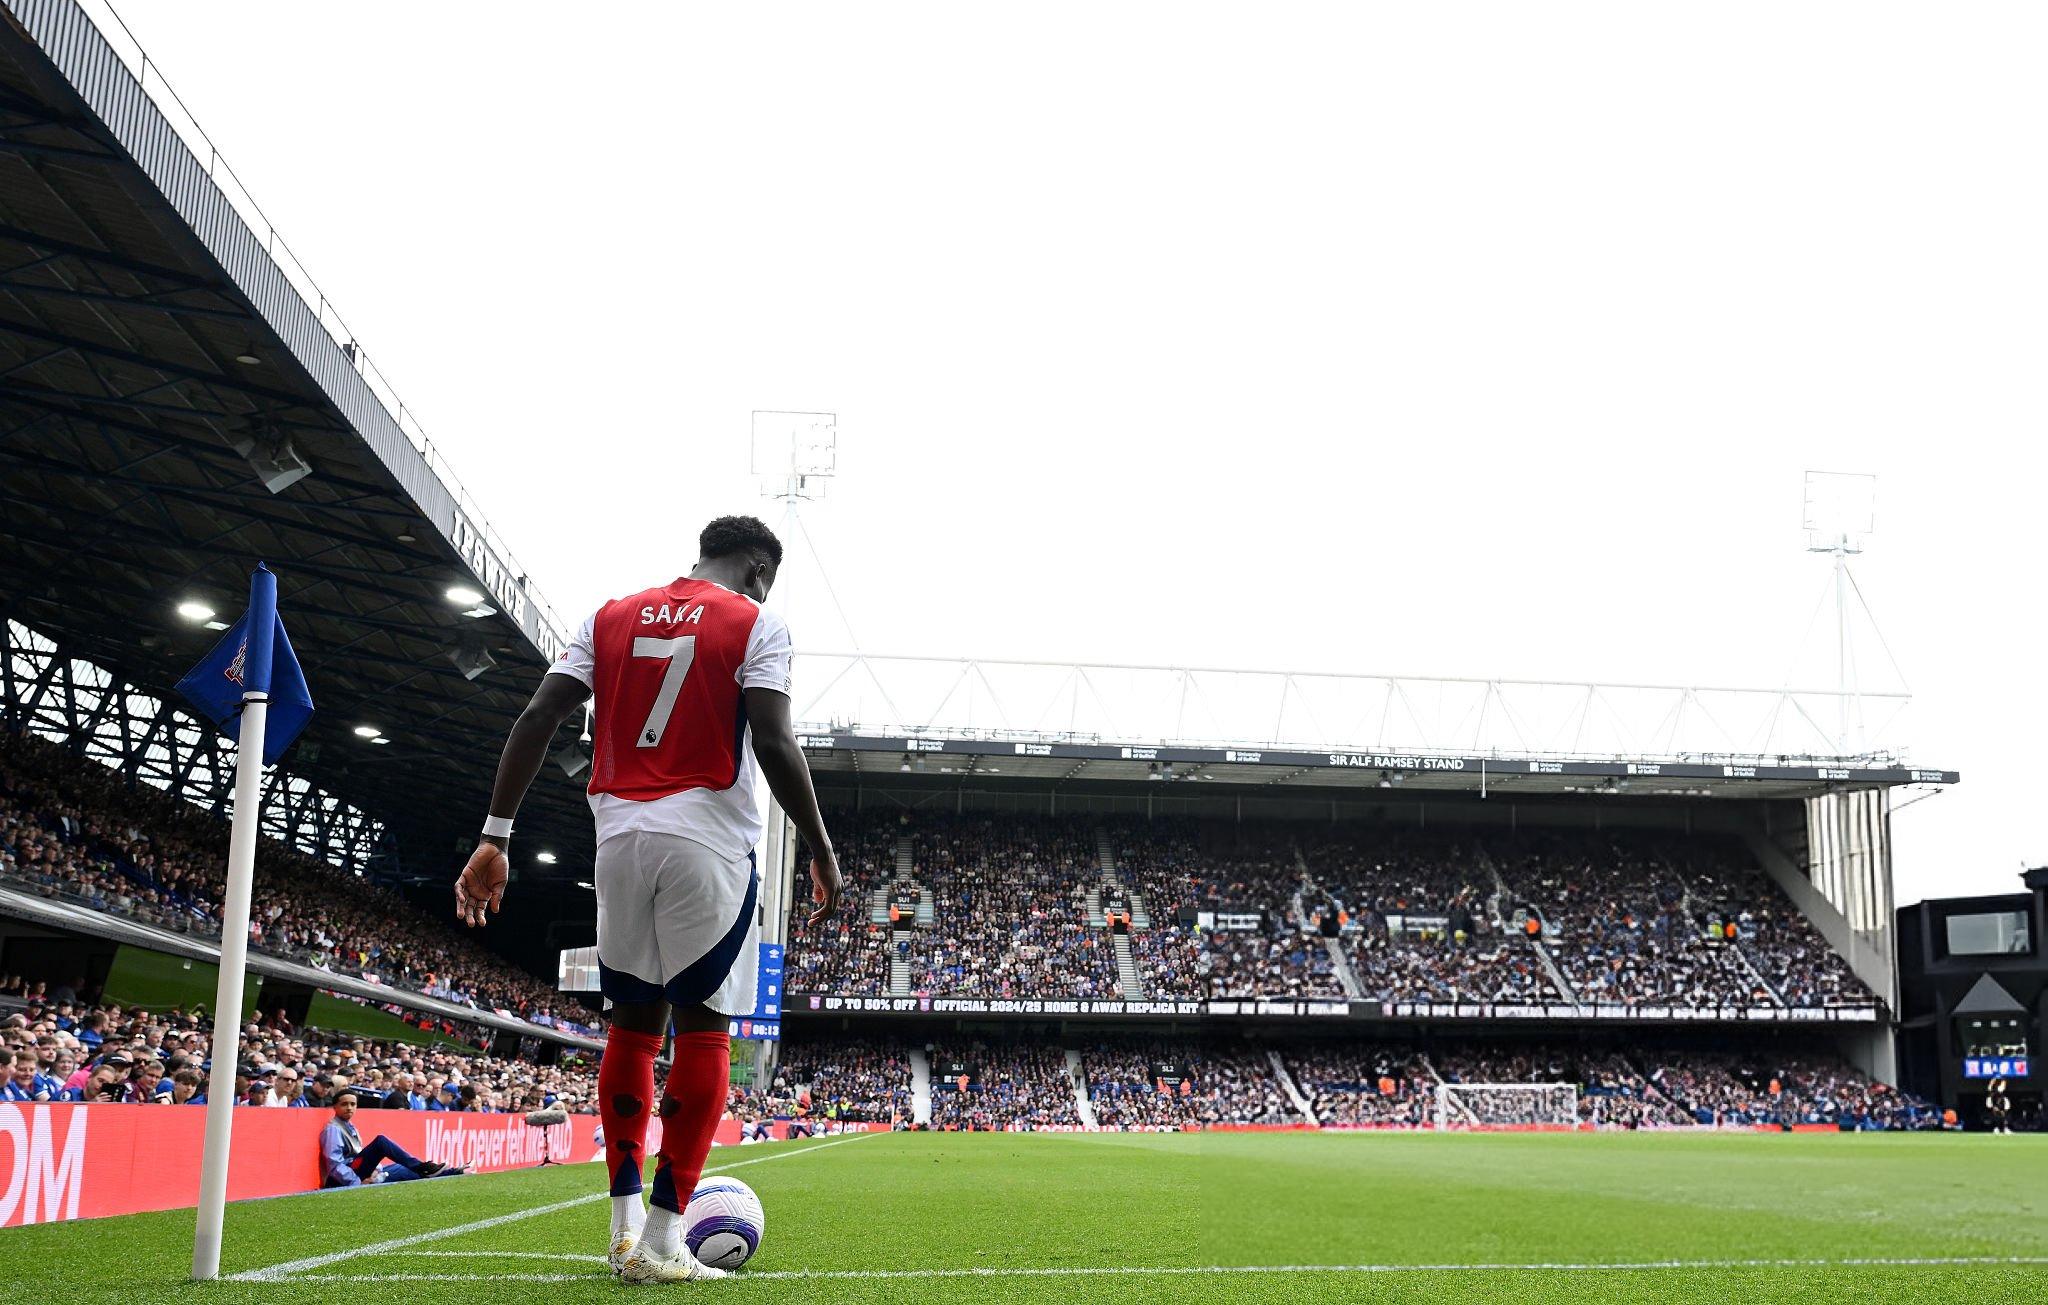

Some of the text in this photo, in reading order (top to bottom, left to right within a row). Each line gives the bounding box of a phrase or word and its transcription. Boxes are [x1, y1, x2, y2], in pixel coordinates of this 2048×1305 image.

[451, 510, 566, 662] IPSWICH TO
[641, 604, 704, 625] SAKA
[633, 635, 696, 748] 7
[1329, 755, 1464, 770] SIR ALF RAMSEY STAND
[825, 998, 842, 1009] UP
[844, 998, 861, 1010] TO
[864, 999, 890, 1010] 50%
[893, 999, 917, 1011] OFF
[933, 1000, 988, 1012] OFFICIAL
[990, 1001, 1041, 1013] 2024/25
[1044, 1001, 1078, 1013] HOME
[1080, 1002, 1089, 1013] &
[1094, 1002, 1125, 1013] AWAY
[1126, 1002, 1176, 1014] REPLICA
[1178, 1003, 1199, 1014] KIT
[425, 1116, 467, 1168] Work
[467, 1128, 506, 1168] never
[505, 1115, 526, 1164] felt
